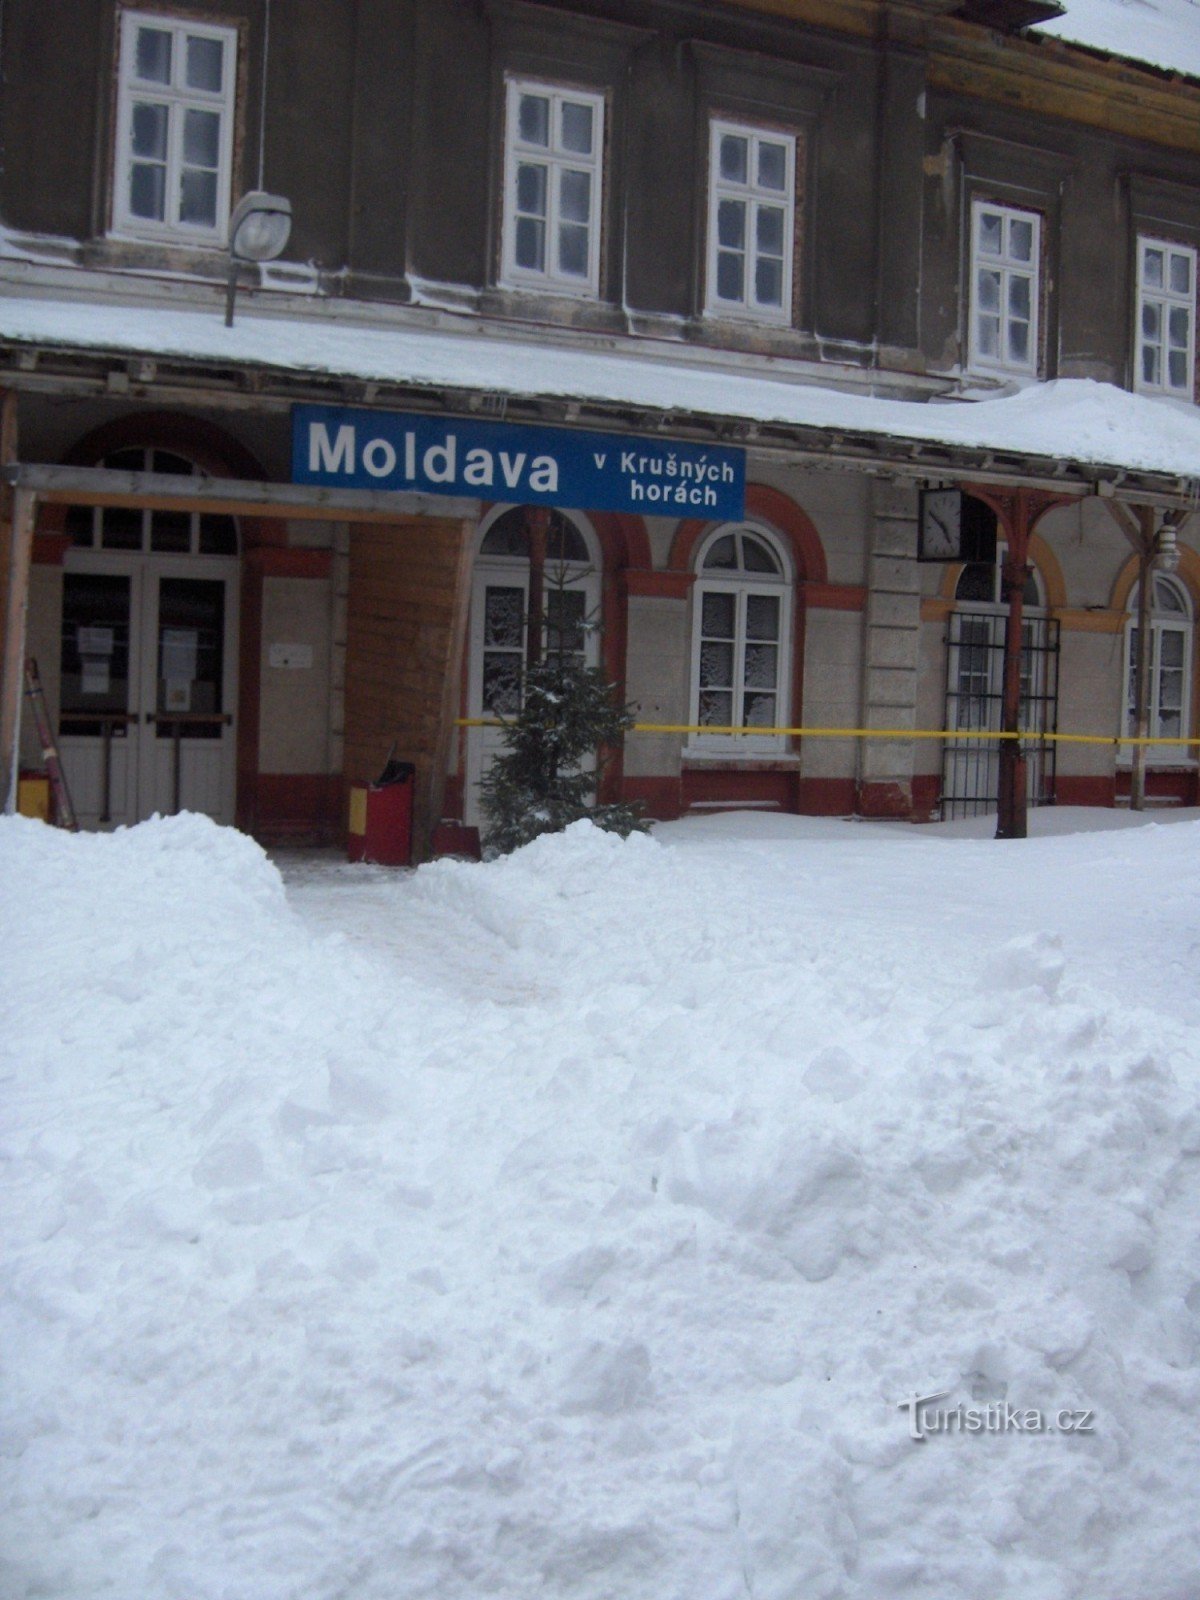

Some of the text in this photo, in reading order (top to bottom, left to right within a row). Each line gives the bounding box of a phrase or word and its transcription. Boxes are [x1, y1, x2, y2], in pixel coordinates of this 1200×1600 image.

[308, 422, 735, 492] Moldava v Krušných
[630, 479, 718, 506] horách
